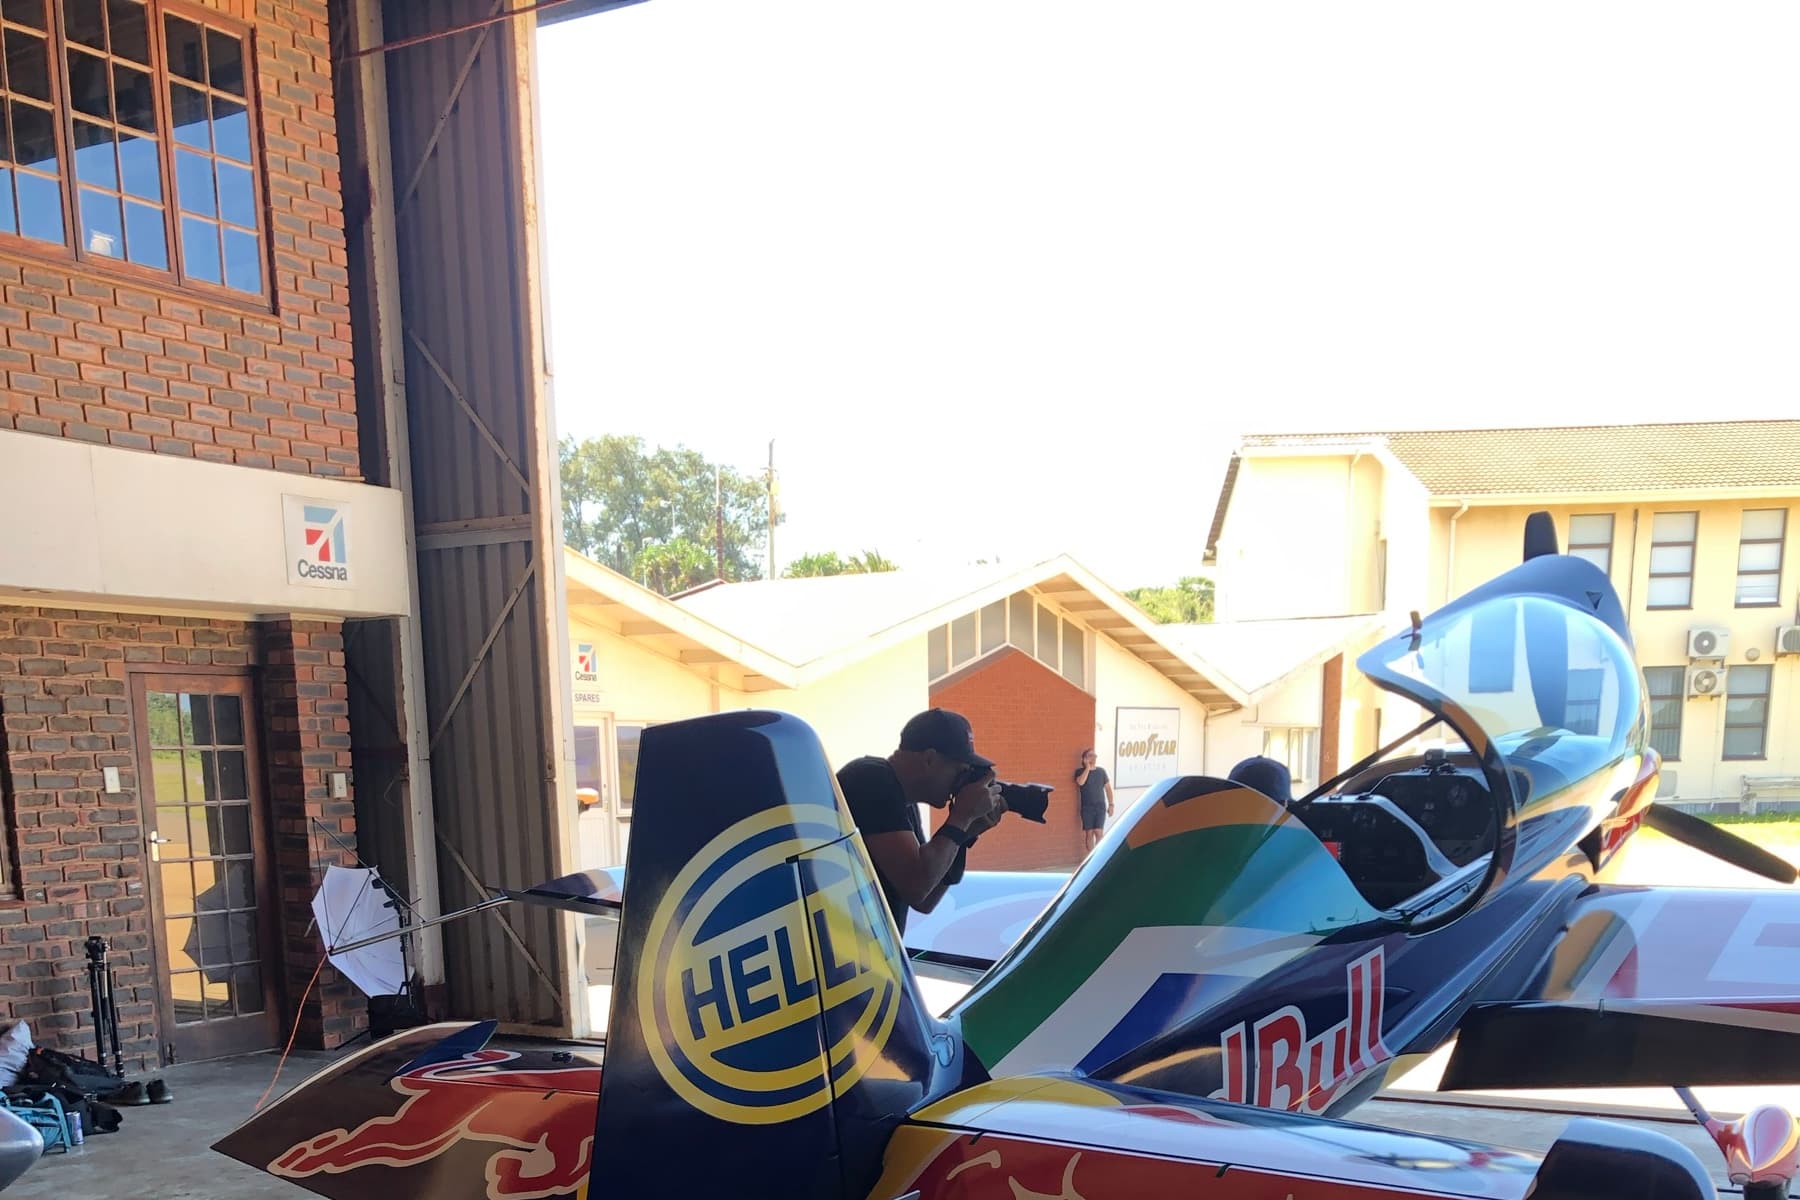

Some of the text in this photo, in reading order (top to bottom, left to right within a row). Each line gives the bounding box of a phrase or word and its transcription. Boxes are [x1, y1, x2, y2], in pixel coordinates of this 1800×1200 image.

[298, 559, 347, 580] Cessna
[575, 693, 600, 702] SPARES
[1253, 944, 1394, 1115] Bull
